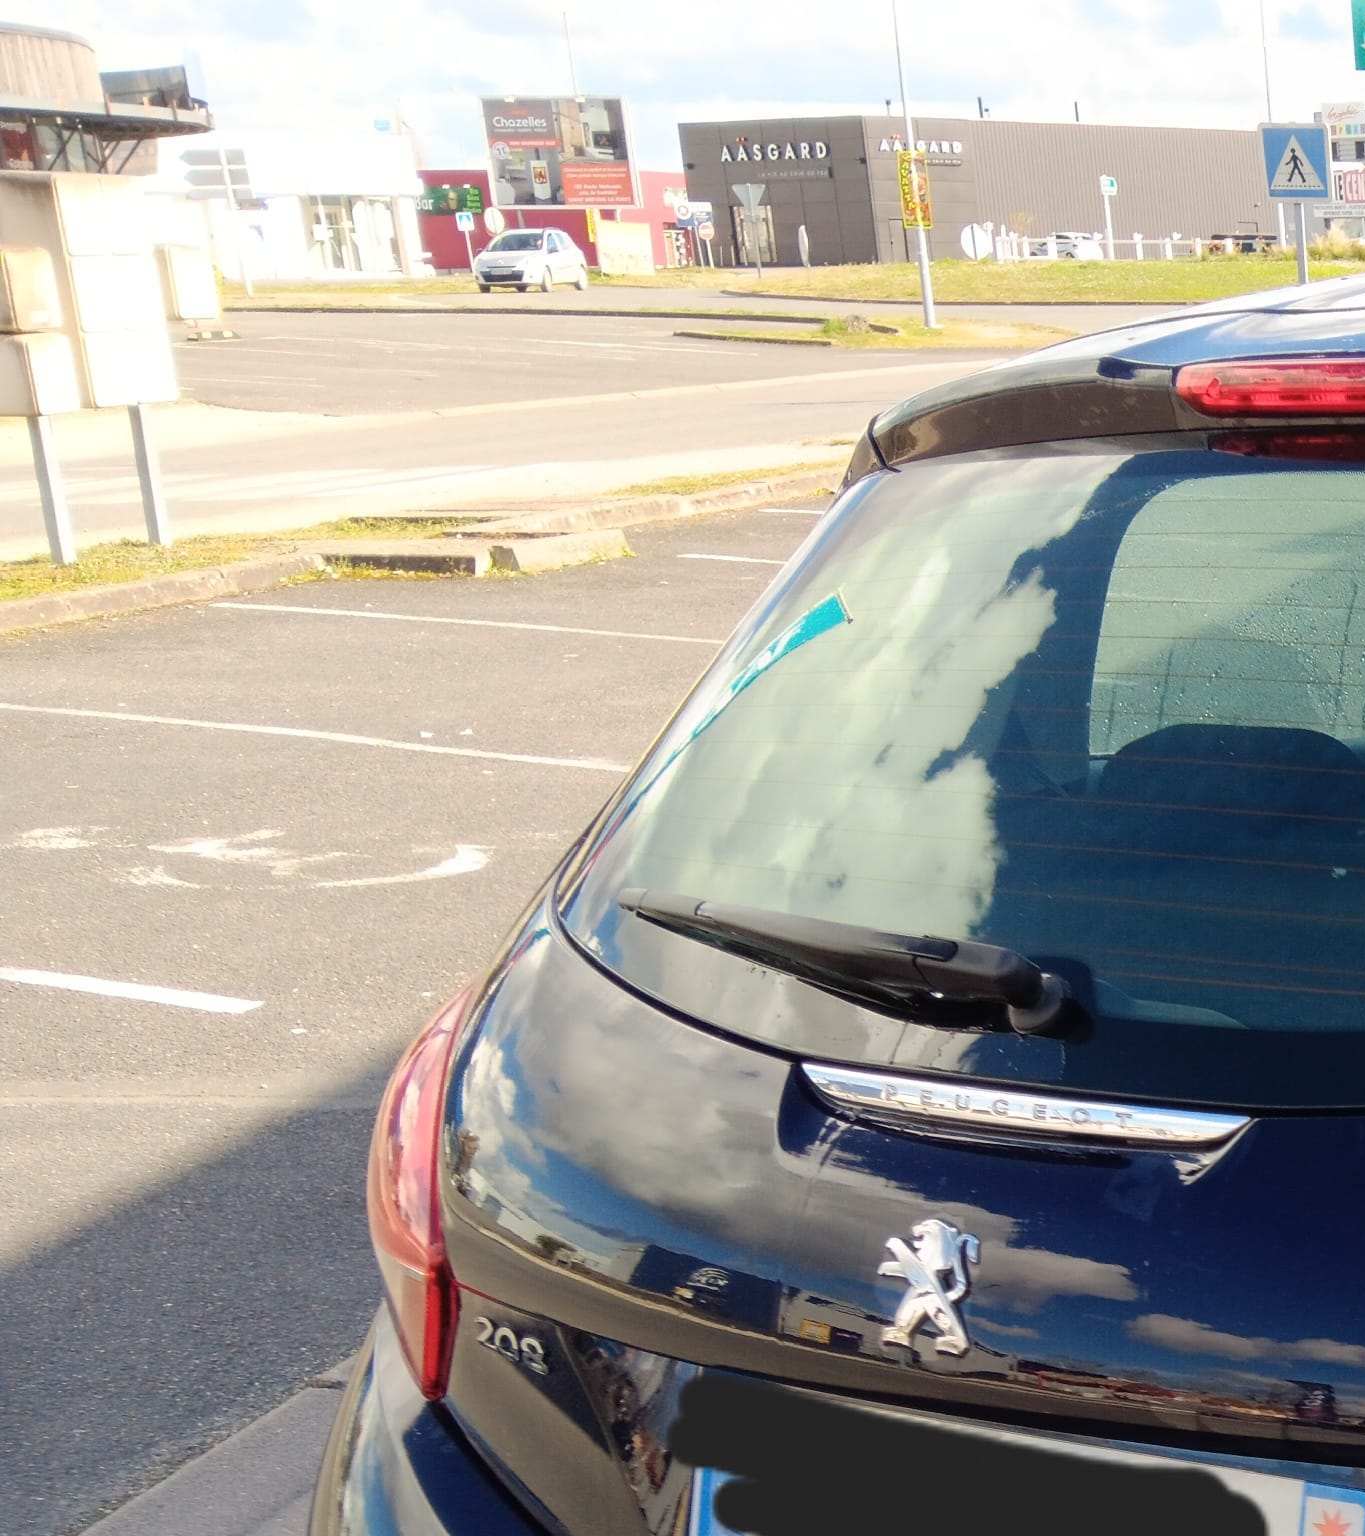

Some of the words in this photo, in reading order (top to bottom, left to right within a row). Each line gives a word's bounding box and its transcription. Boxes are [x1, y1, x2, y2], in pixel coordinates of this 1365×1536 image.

[492, 116, 547, 128] Chazelles
[879, 138, 963, 154] AAGARD
[881, 1083, 1134, 1130] PEUGEOT
[474, 1315, 549, 1376] 208
